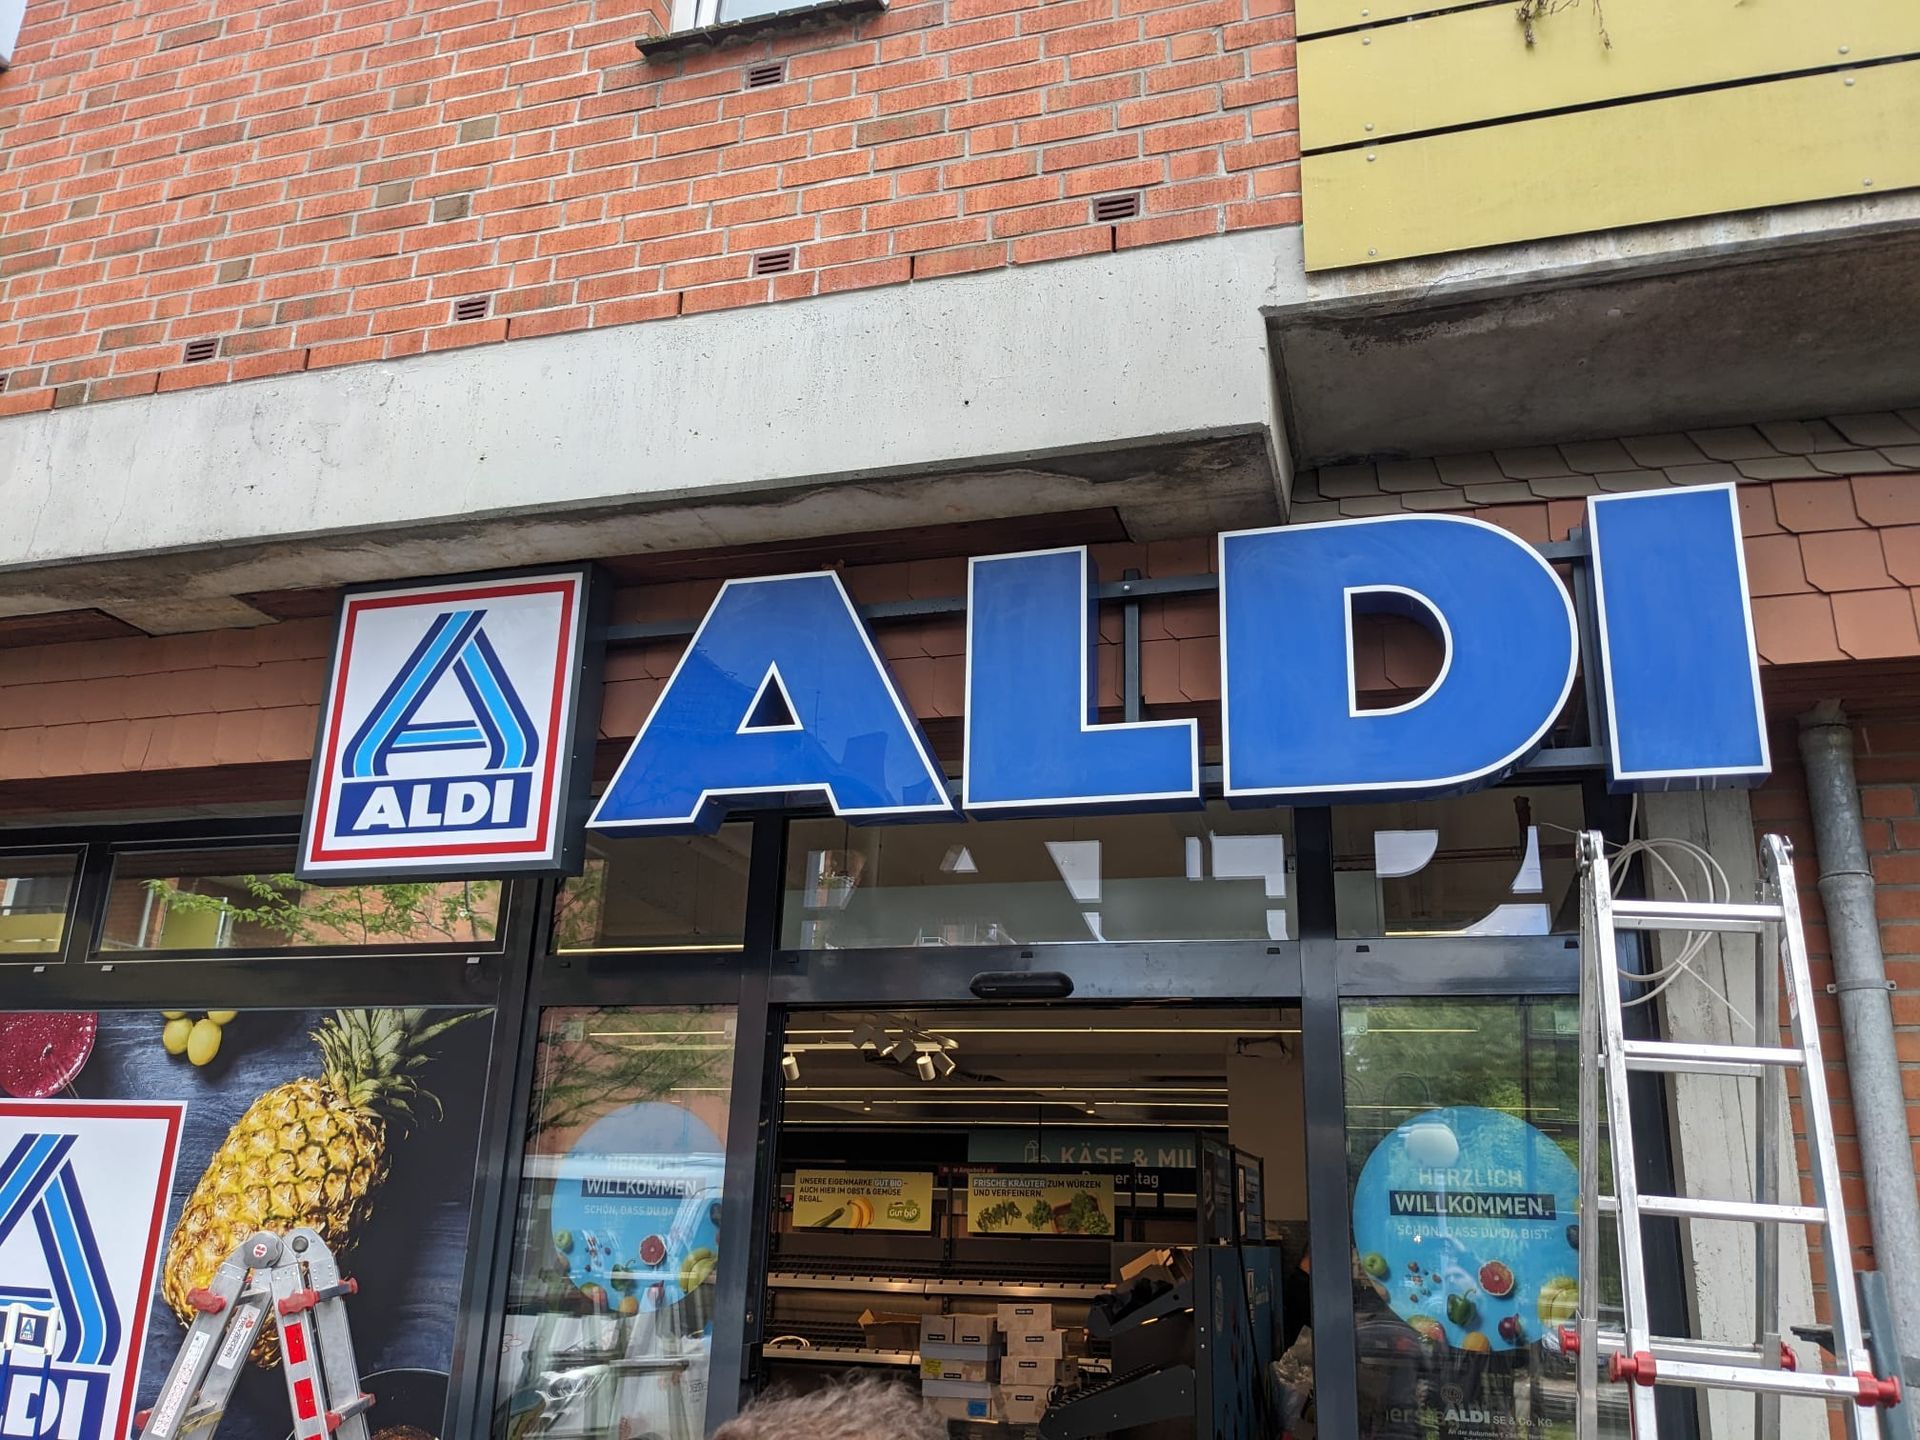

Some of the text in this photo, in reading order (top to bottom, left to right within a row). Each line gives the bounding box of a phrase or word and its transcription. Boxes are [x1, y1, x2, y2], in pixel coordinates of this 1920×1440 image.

[587, 481, 1773, 830] ALDI
[352, 779, 514, 831] ALDI
[1061, 1141, 1123, 1164] KÄSE
[1134, 1148, 1148, 1167] &
[799, 1177, 827, 1185] UNSERE
[828, 1178, 872, 1186] EIGENMARKE
[973, 1178, 1007, 1187] FRISCHE
[1047, 1180, 1065, 1188] ZUM
[1418, 1168, 1523, 1187] HERZLICH
[837, 1187, 845, 1195] IM
[847, 1187, 865, 1195] OBST
[973, 1189, 1044, 1198] UND VERFEINERN.
[620, 1205, 644, 1216] DASS
[1395, 1193, 1550, 1216] WILLKOMMEN.
[1446, 1226, 1477, 1238] DASS
[1521, 1227, 1552, 1240] BIST.
[1444, 1409, 1491, 1424] ALDI
[1493, 1415, 1507, 1425] SE
[1509, 1416, 1516, 1425] &
